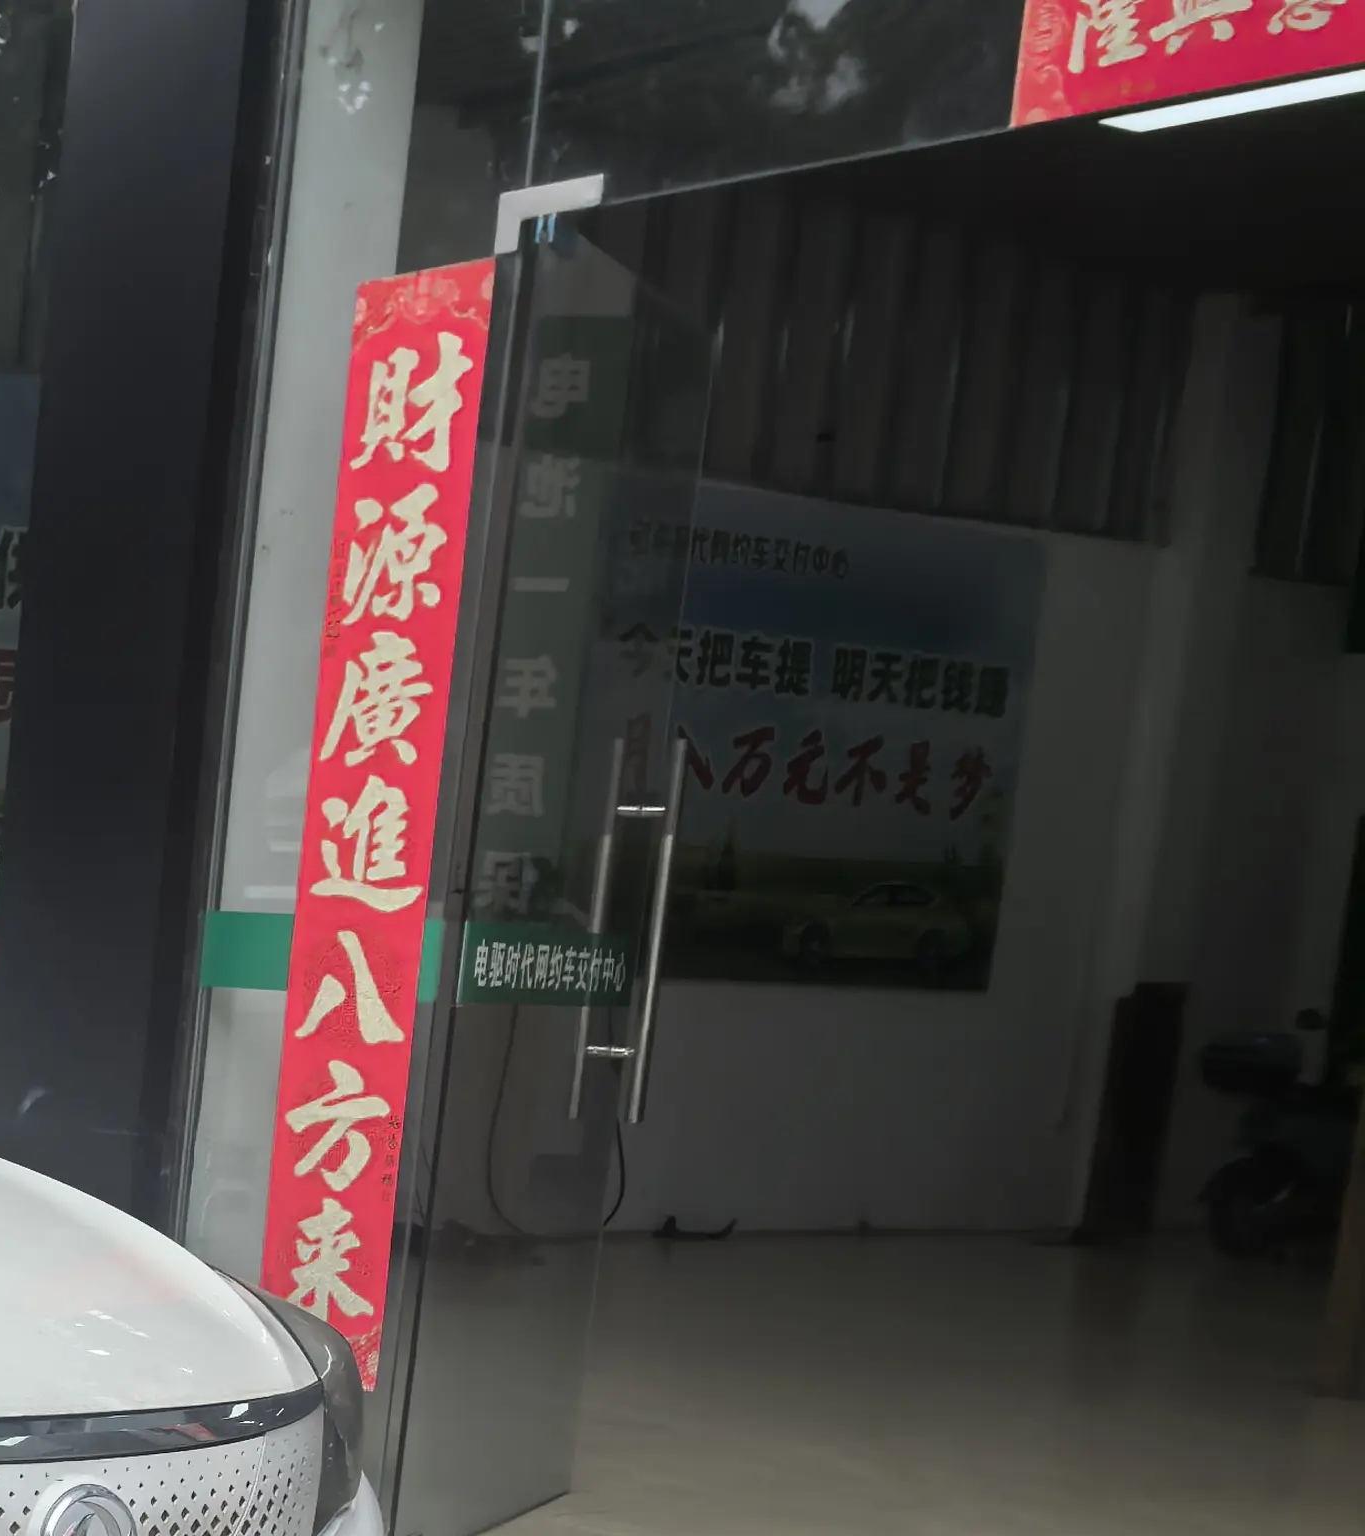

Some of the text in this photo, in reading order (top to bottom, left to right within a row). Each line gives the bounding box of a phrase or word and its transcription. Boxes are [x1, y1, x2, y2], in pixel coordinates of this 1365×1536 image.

[474, 938, 626, 993] 电驱时代网约车交付中心
